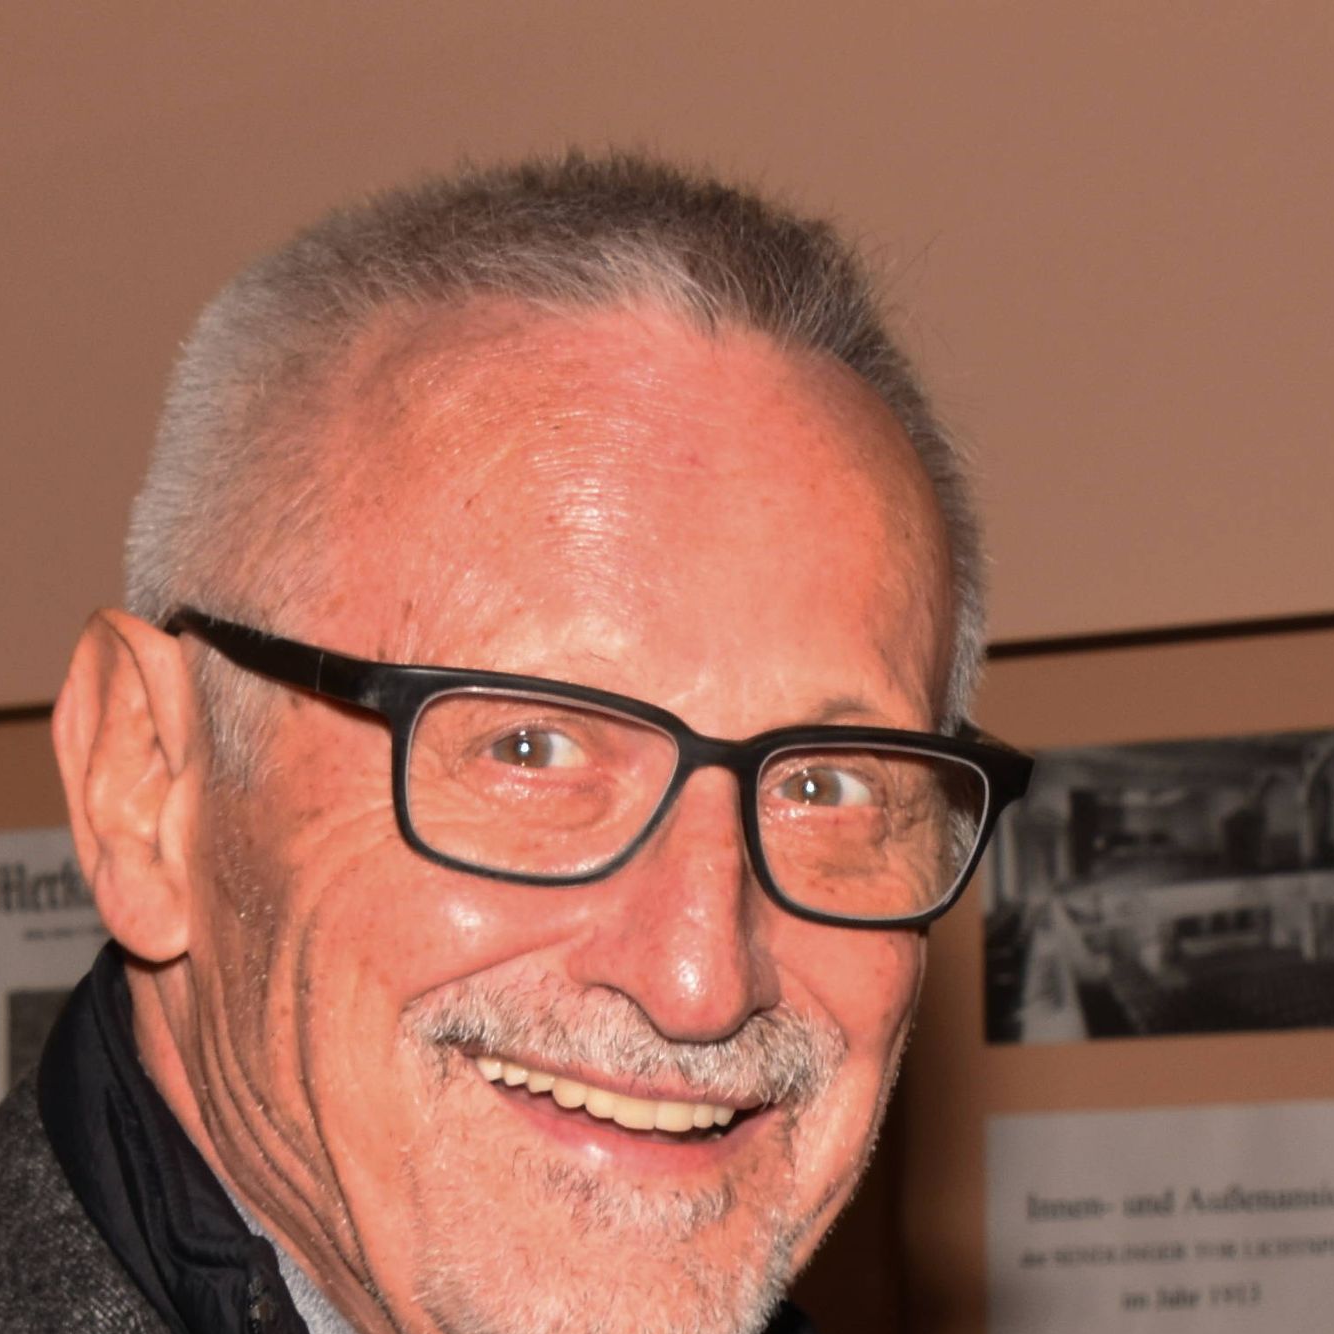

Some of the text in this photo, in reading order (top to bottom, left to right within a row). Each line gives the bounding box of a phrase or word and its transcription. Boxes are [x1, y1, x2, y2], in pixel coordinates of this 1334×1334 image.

[1028, 1192, 1113, 1220] Innen-
[1123, 1188, 1175, 1217] und
[1122, 1292, 1149, 1310] im
